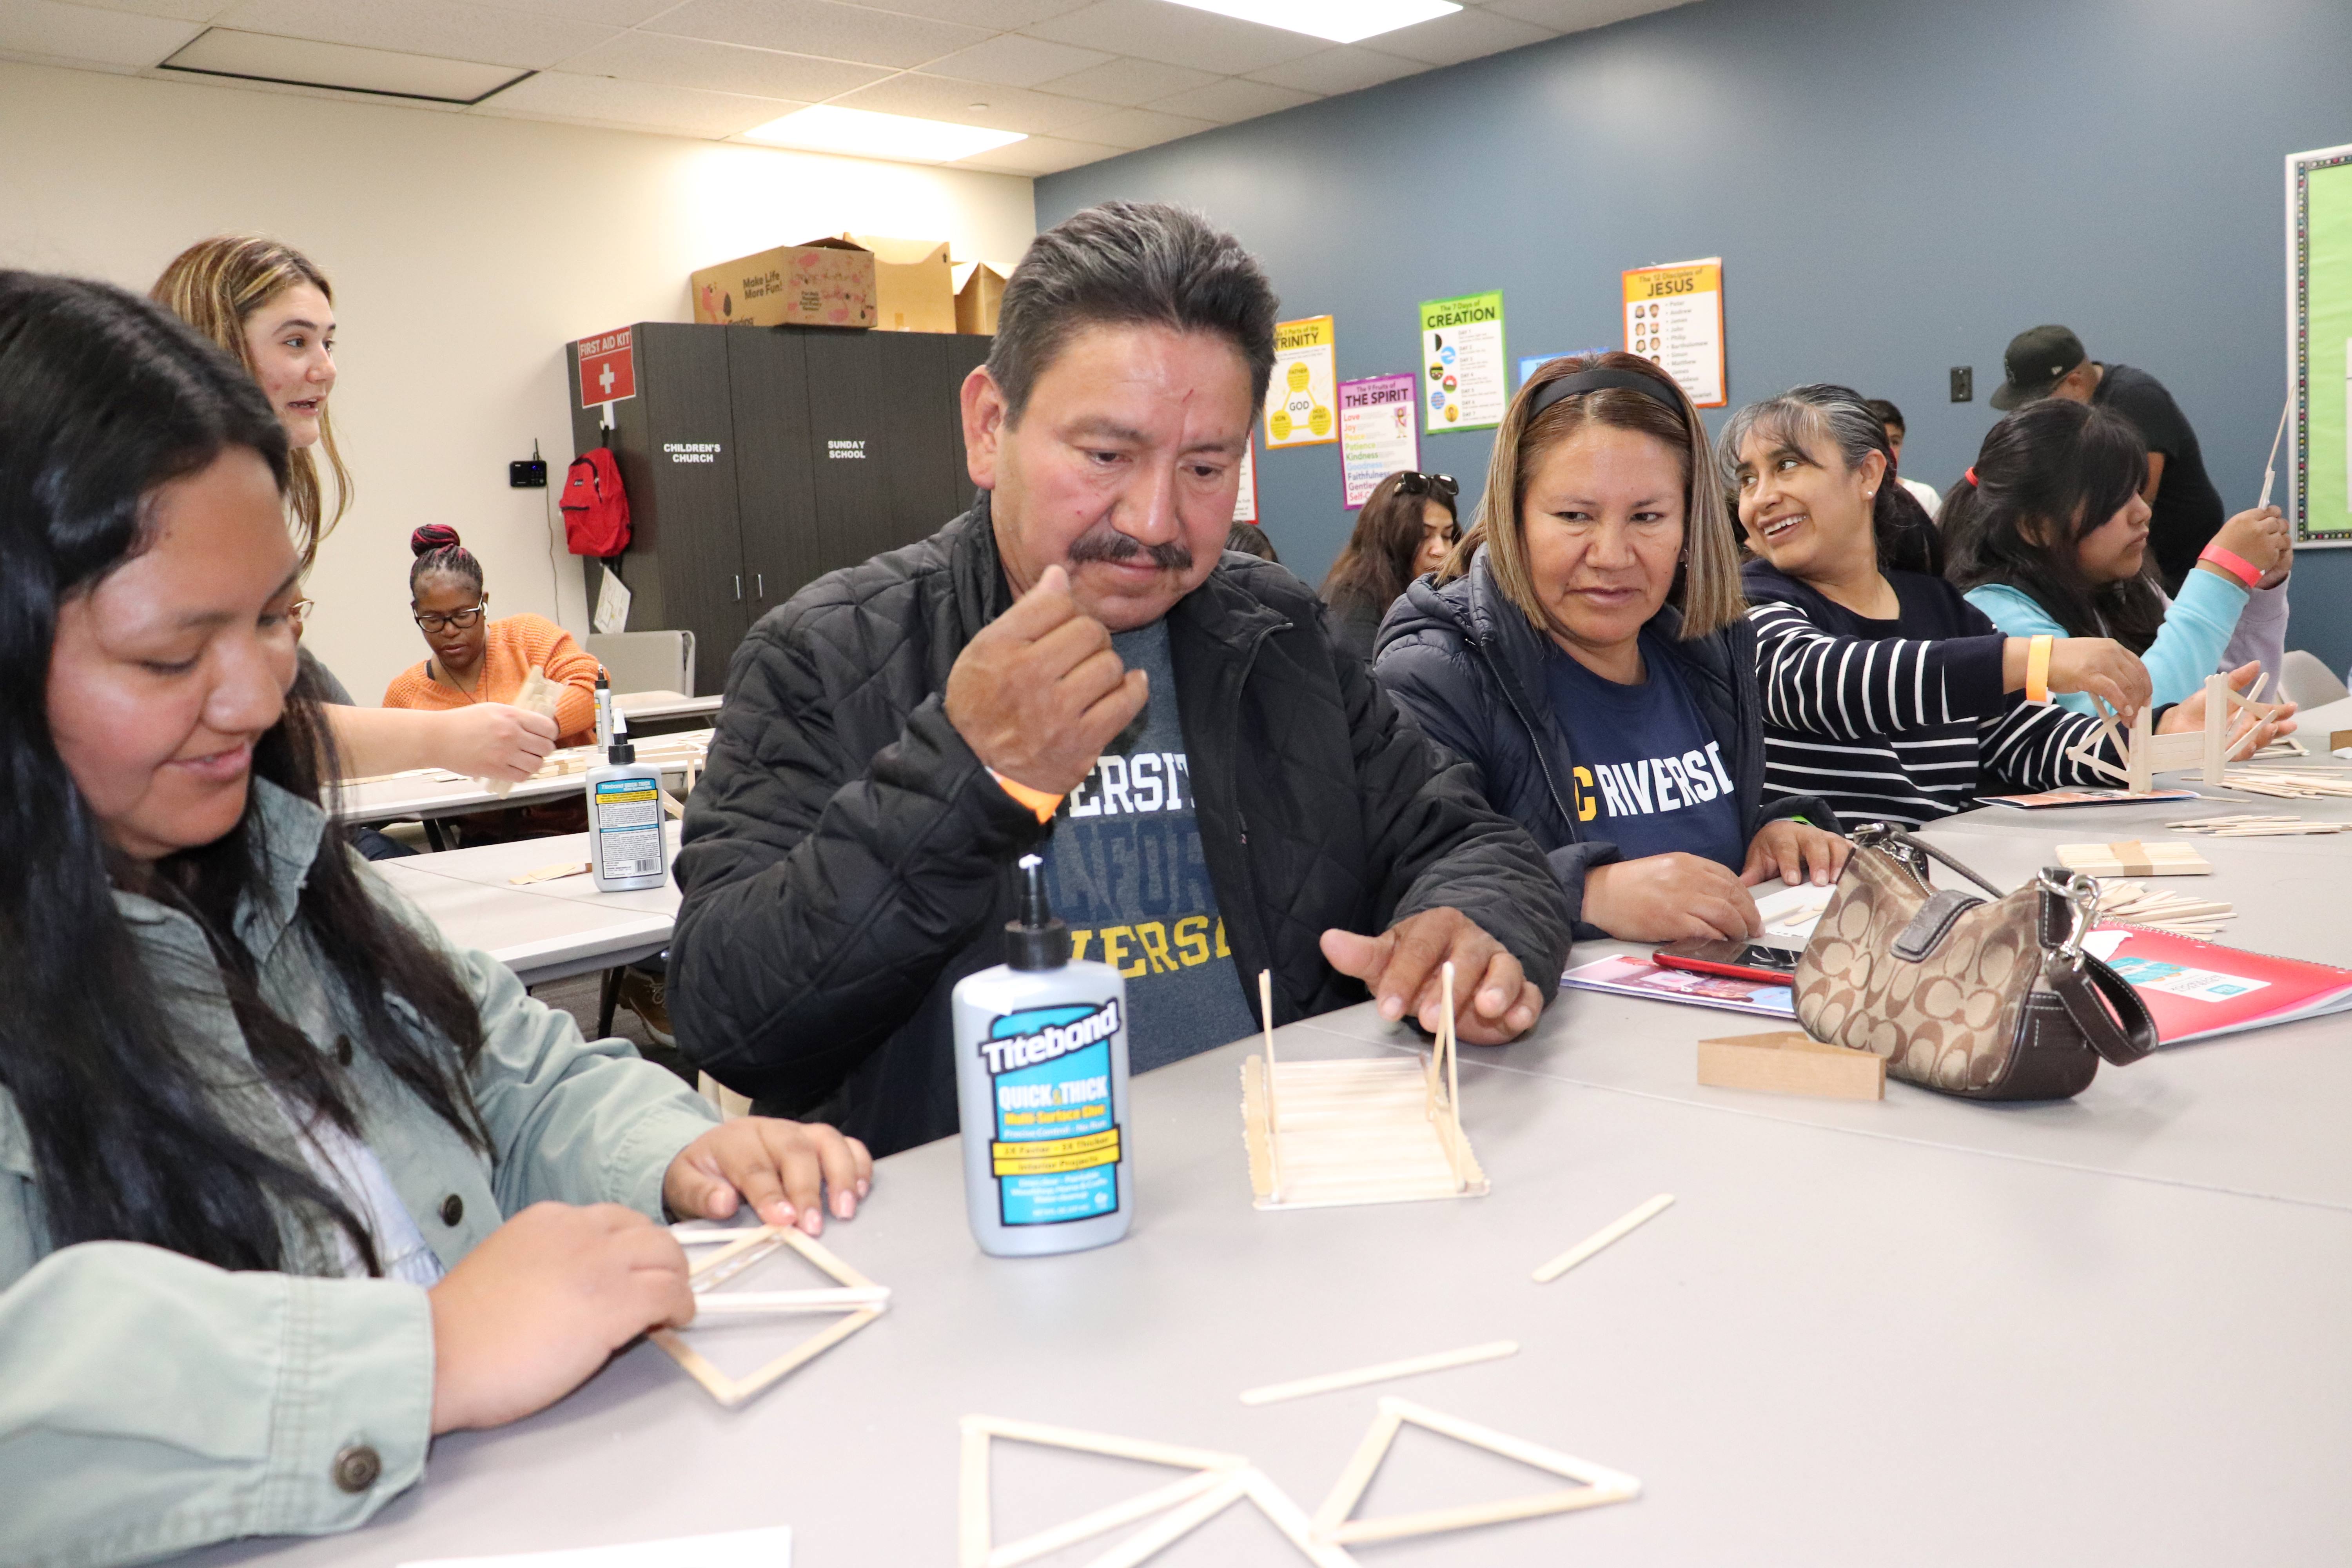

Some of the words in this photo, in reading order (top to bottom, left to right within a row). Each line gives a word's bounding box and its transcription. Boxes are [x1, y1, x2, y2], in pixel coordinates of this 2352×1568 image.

[743, 276, 764, 289] Make
[765, 271, 780, 286] Life
[745, 286, 764, 300] More
[766, 281, 782, 295] Fun!
[1648, 278, 1694, 297] JESUS
[1428, 307, 1495, 328] CREATION
[580, 339, 601, 356] FIRST
[602, 336, 615, 350] AID
[617, 331, 630, 347] KIT
[1345, 394, 1368, 407] THE
[1371, 388, 1409, 404] SPIRIT
[1289, 401, 1310, 411] GOD
[1343, 414, 1360, 422] Love
[1344, 424, 1356, 433] Joy
[663, 443, 721, 453] CHILDREN'S
[828, 440, 866, 449] SUNDAY
[1345, 442, 1376, 451] Patience
[672, 454, 714, 463] CHURCH
[829, 450, 866, 459] SCHOOL
[1346, 451, 1379, 461] Kindness
[1348, 481, 1377, 491] Gentlen
[1069, 753, 1195, 817] ERSI
[982, 1001, 1117, 1073] Titebond
[998, 1084, 1052, 1111] QUICK
[1059, 1075, 1109, 1105] THICK
